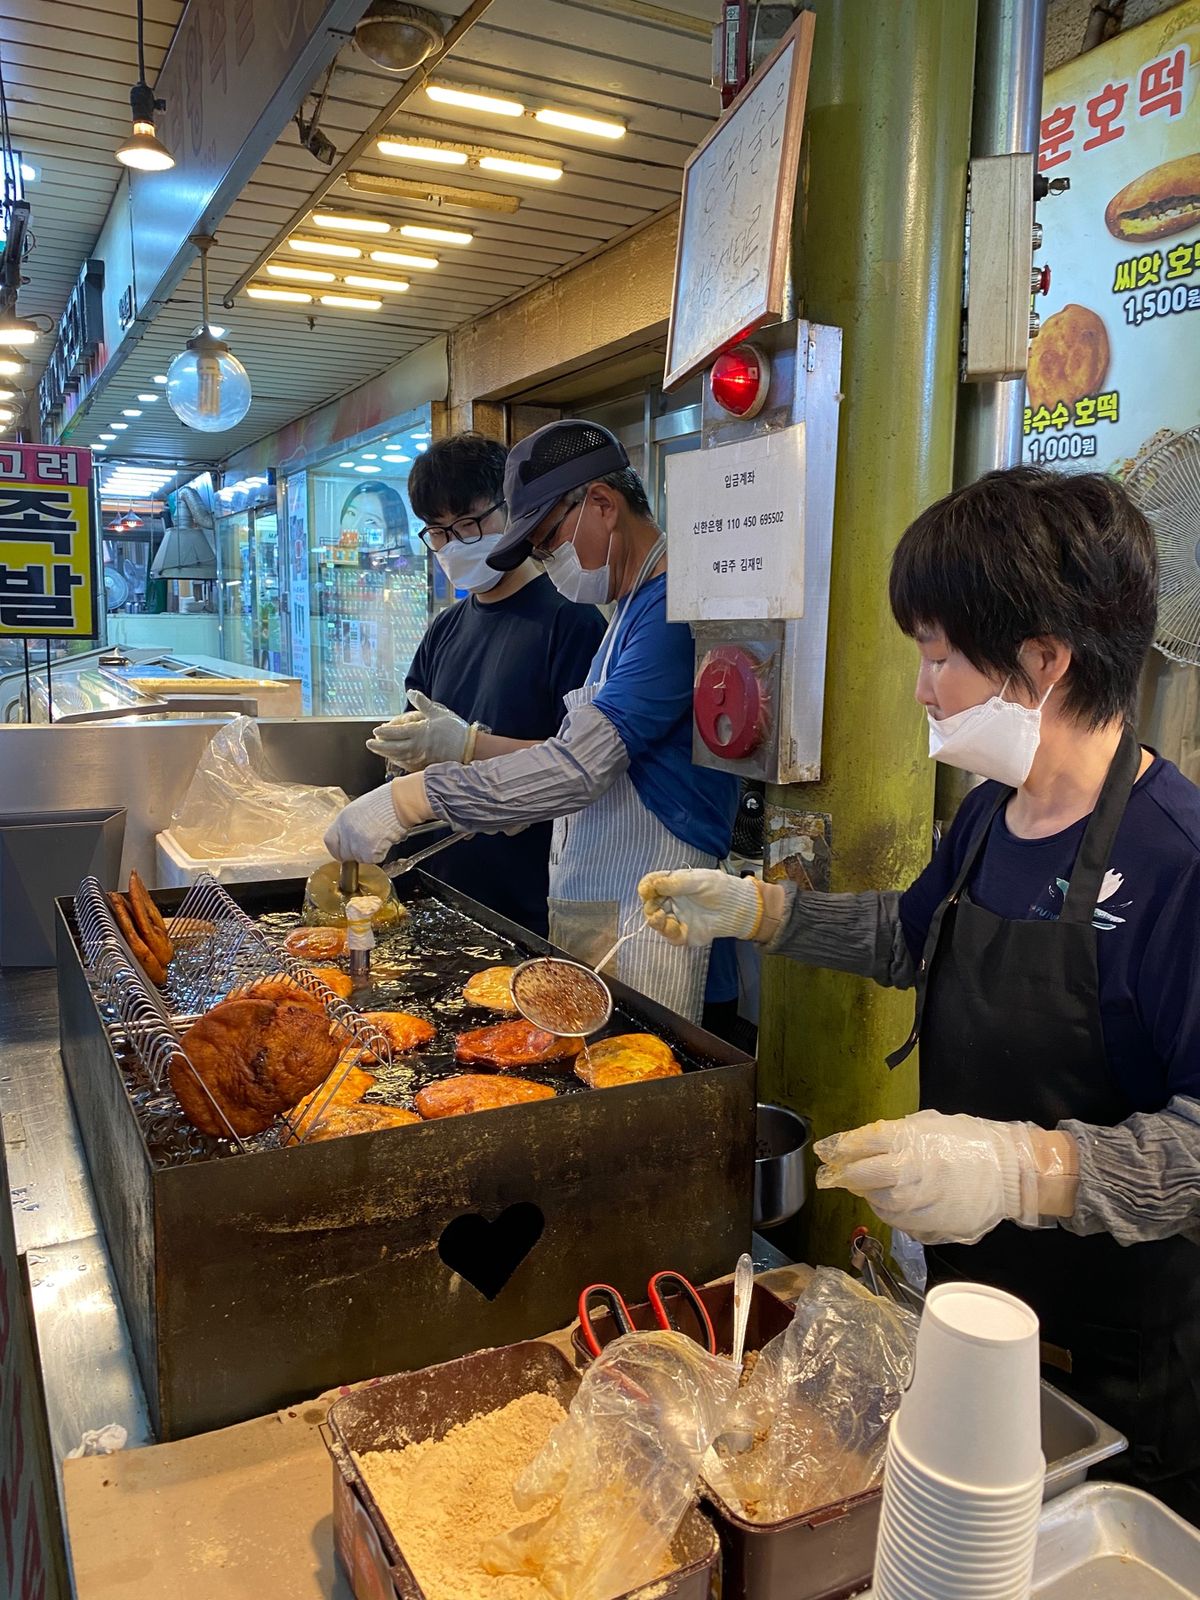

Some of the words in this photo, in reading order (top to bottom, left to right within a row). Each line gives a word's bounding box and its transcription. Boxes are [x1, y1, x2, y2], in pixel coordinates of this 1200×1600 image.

[1114, 252, 1162, 292] 씨앗
[1167, 242, 1200, 279] 호
[1074, 393, 1118, 426] 호떡
[1030, 434, 1095, 464] 1,000원
[0, 450, 78, 485] 고려
[724, 470, 755, 489] 입금계좌
[693, 518, 723, 535] 신한은행
[727, 518, 740, 530] 110
[743, 515, 757, 528] 450
[759, 511, 784, 526] 695502
[0, 490, 83, 628] 족발
[712, 559, 736, 574] 예금주
